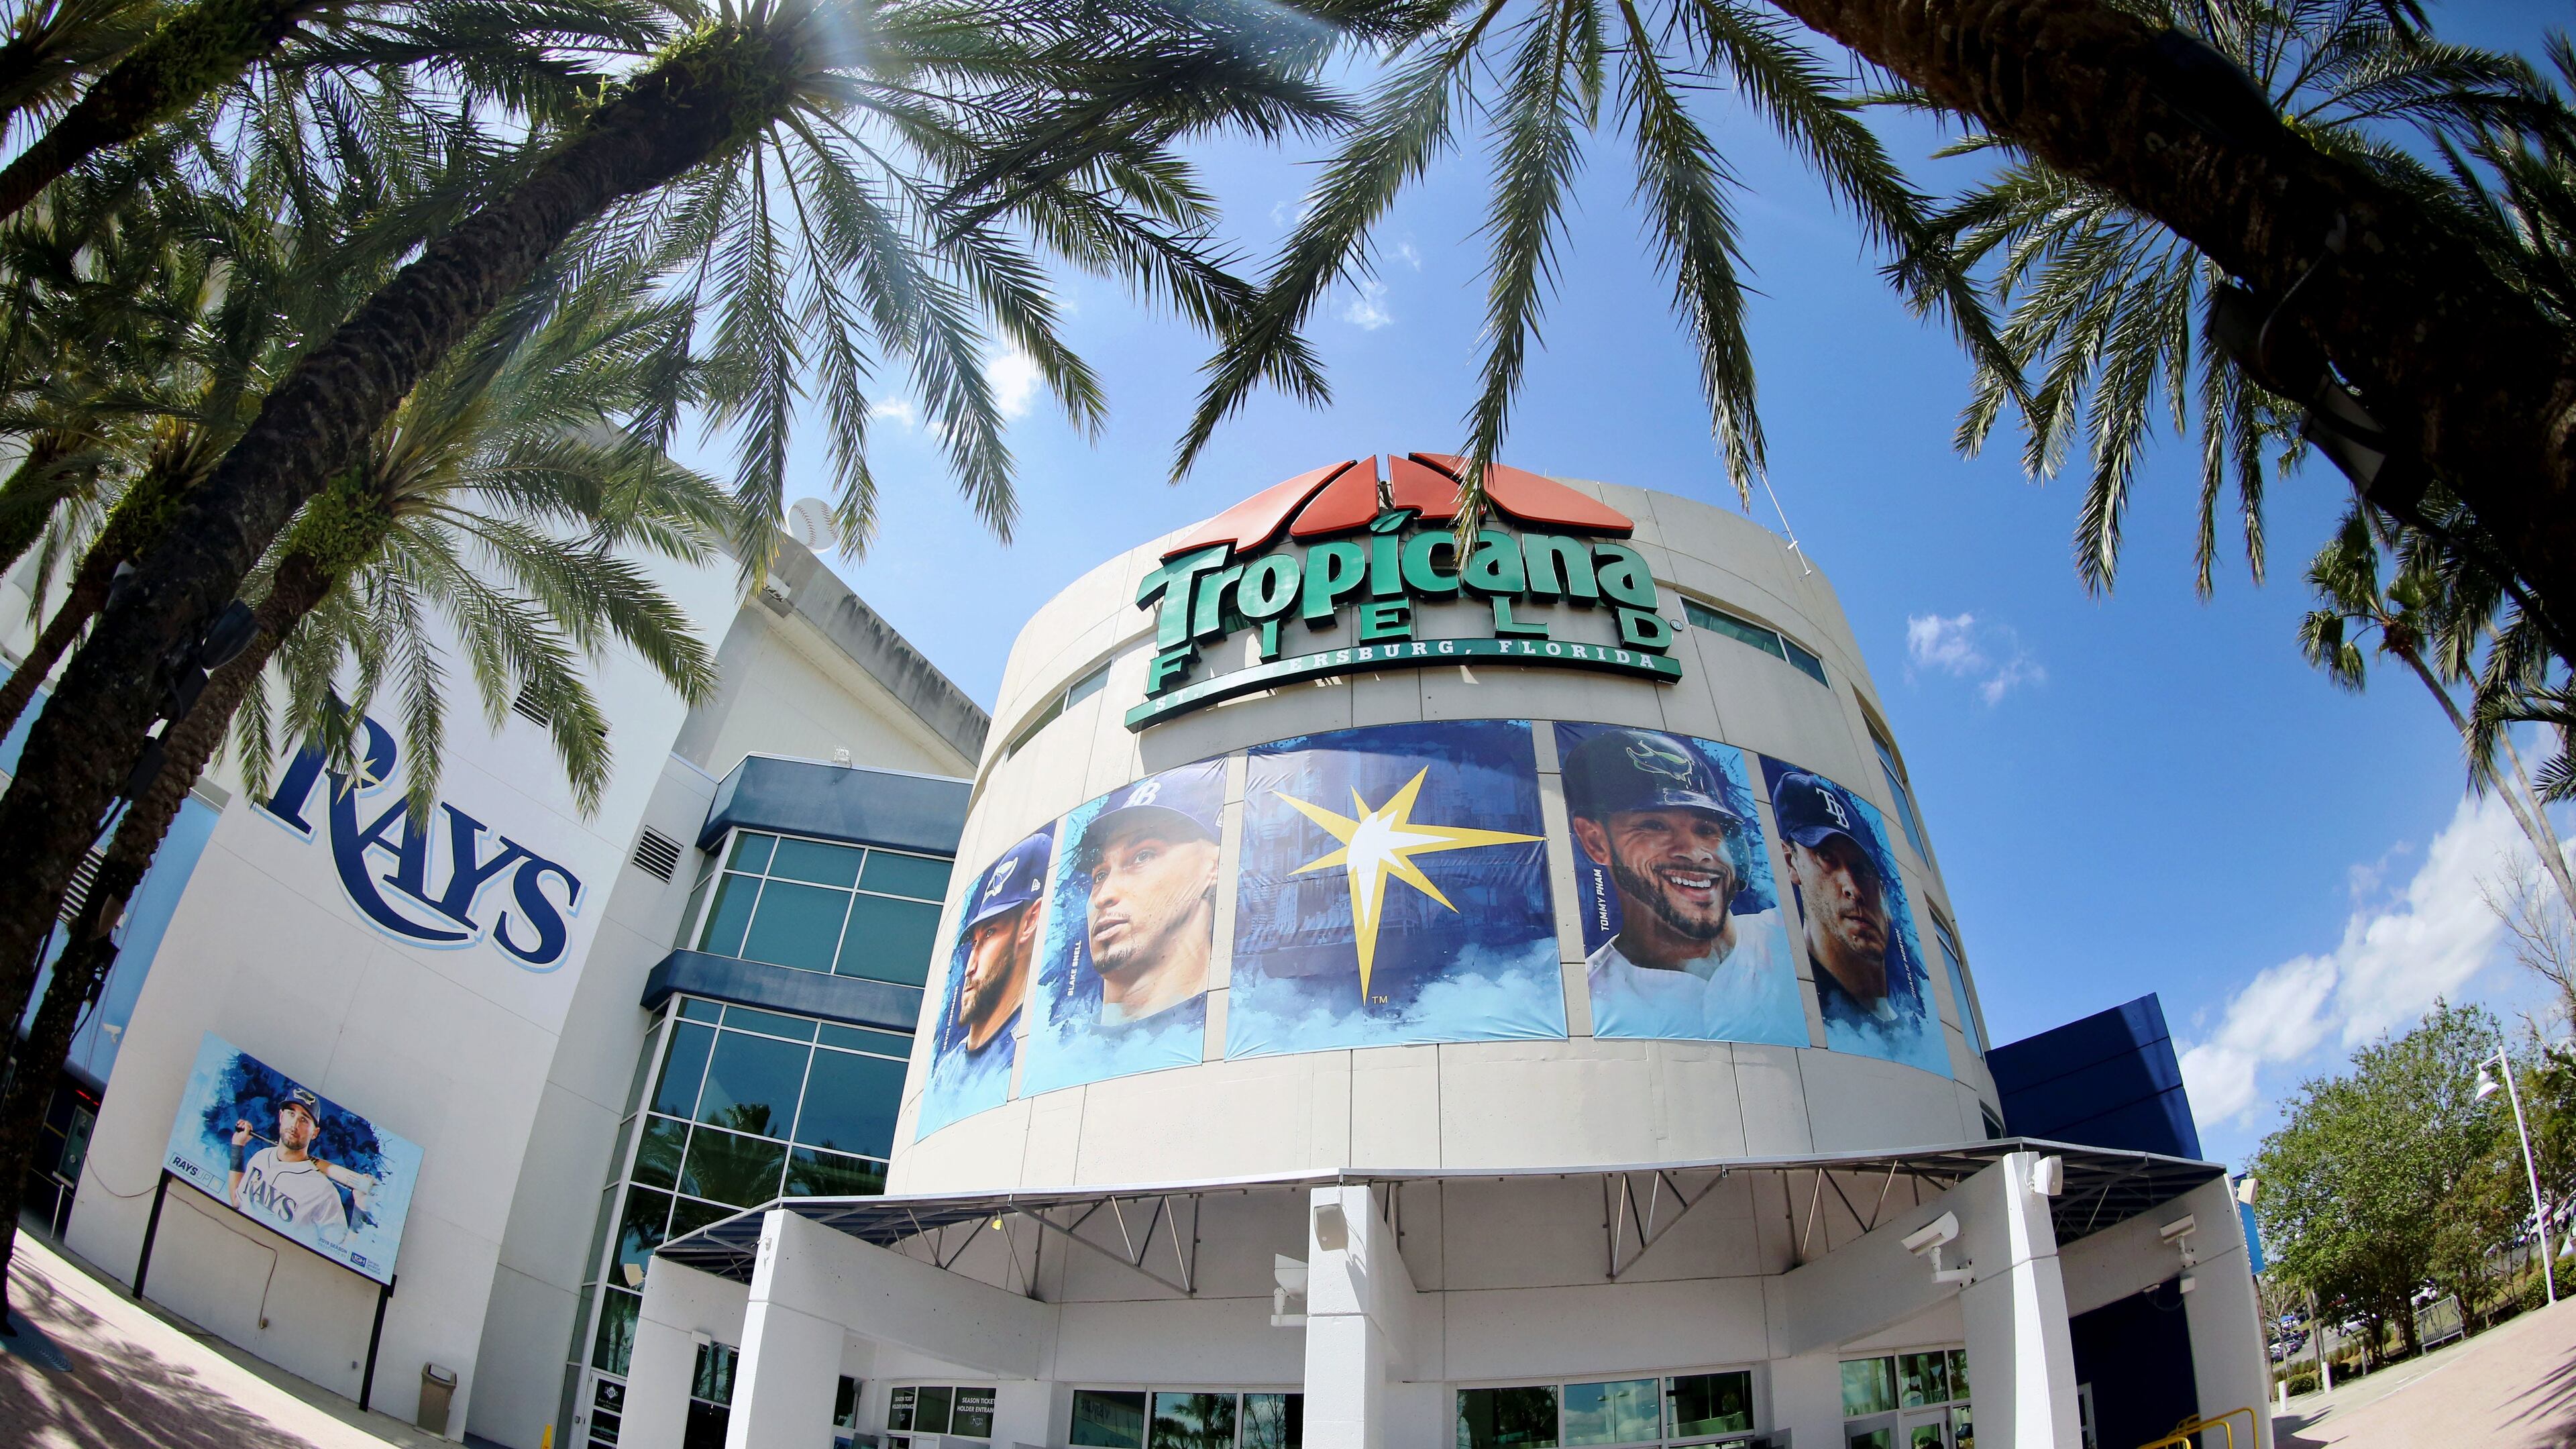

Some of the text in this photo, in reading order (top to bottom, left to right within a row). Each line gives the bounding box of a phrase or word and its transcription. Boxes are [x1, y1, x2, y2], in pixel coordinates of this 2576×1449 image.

[1135, 511, 1659, 651] Tropicana
[1144, 595, 1674, 696] FIELD
[1498, 640, 1655, 669] FLORIDA
[251, 684, 585, 971] RAYS
[1593, 868, 1610, 932] TOMMY PHAM
[1067, 940, 1081, 996] BLAKE SNELL
[1894, 928, 1917, 999] CHARLIE MORTON
[1371, 995, 1388, 1004] TM
[243, 1166, 297, 1223] RAYS
[329, 1242, 347, 1254] SEASON
